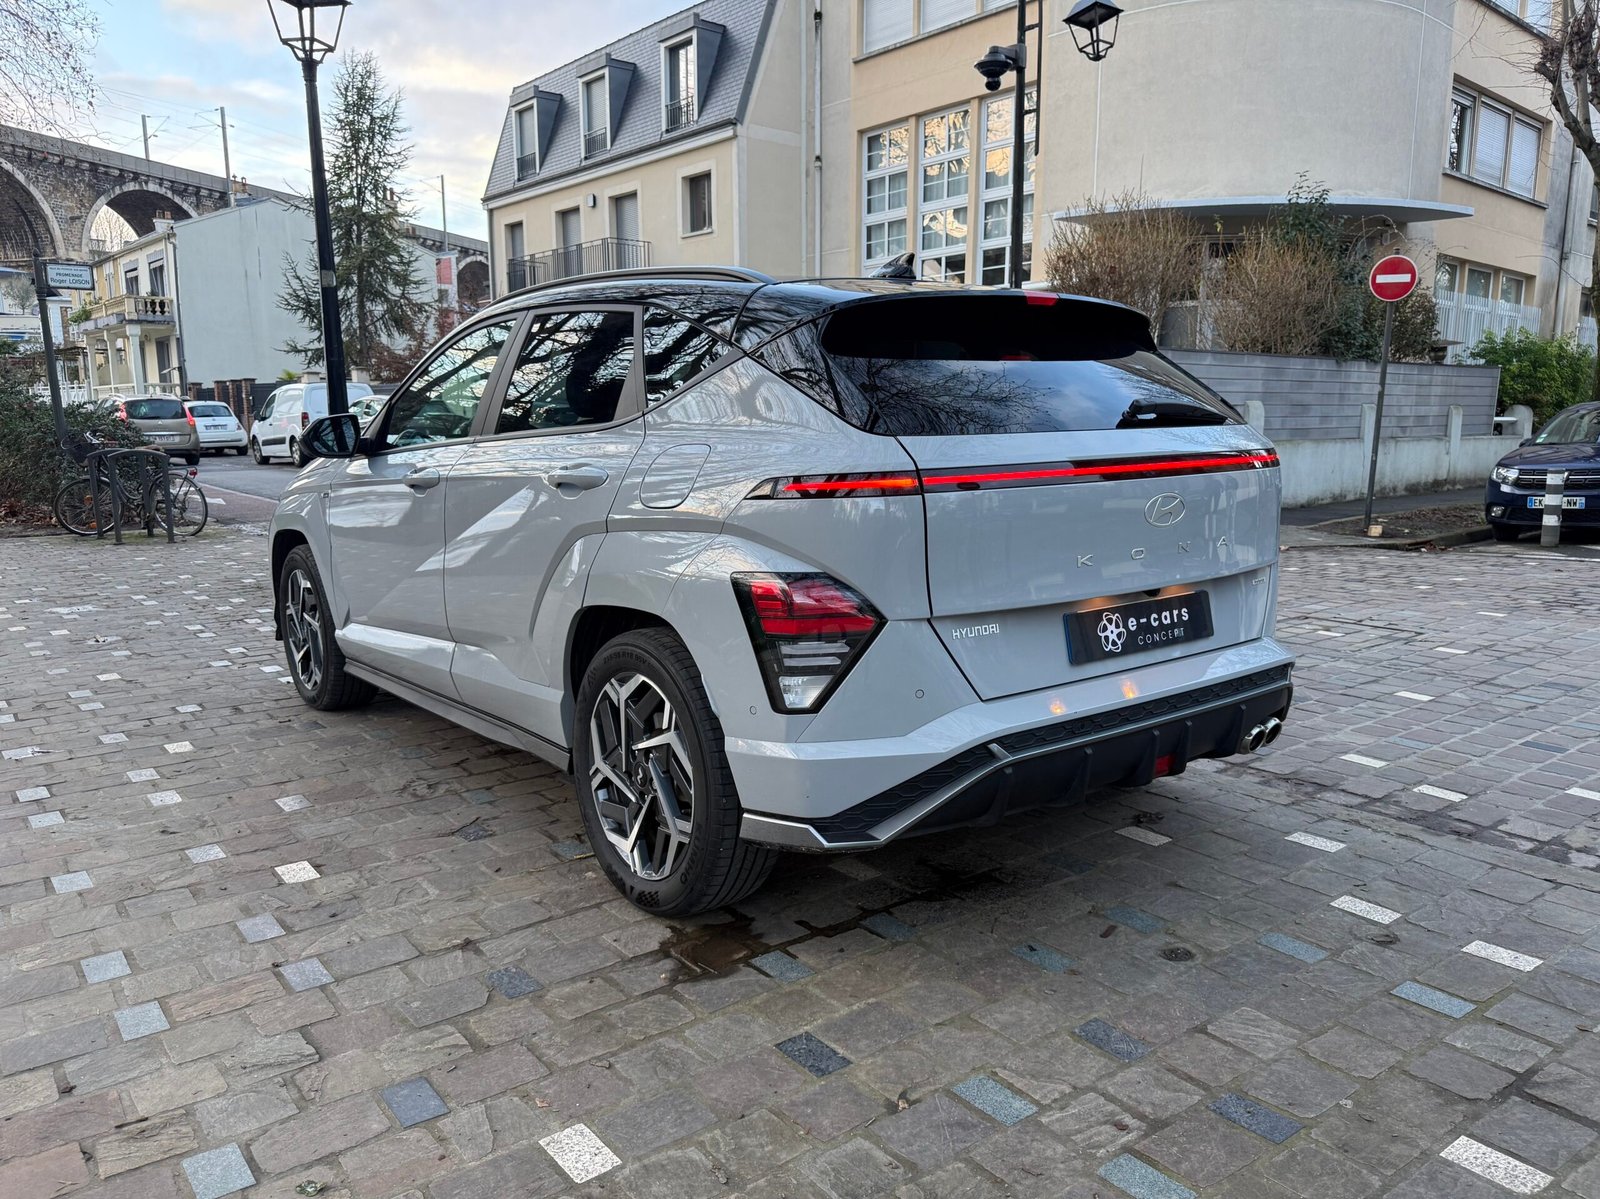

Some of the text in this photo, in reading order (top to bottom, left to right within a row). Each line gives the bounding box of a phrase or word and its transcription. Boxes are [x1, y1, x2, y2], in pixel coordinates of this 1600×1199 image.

[1076, 536, 1229, 569] KONA
[1127, 607, 1189, 631] e-cars
[952, 623, 1000, 640] HYUNDAI
[1137, 627, 1185, 645] CONCEPT
